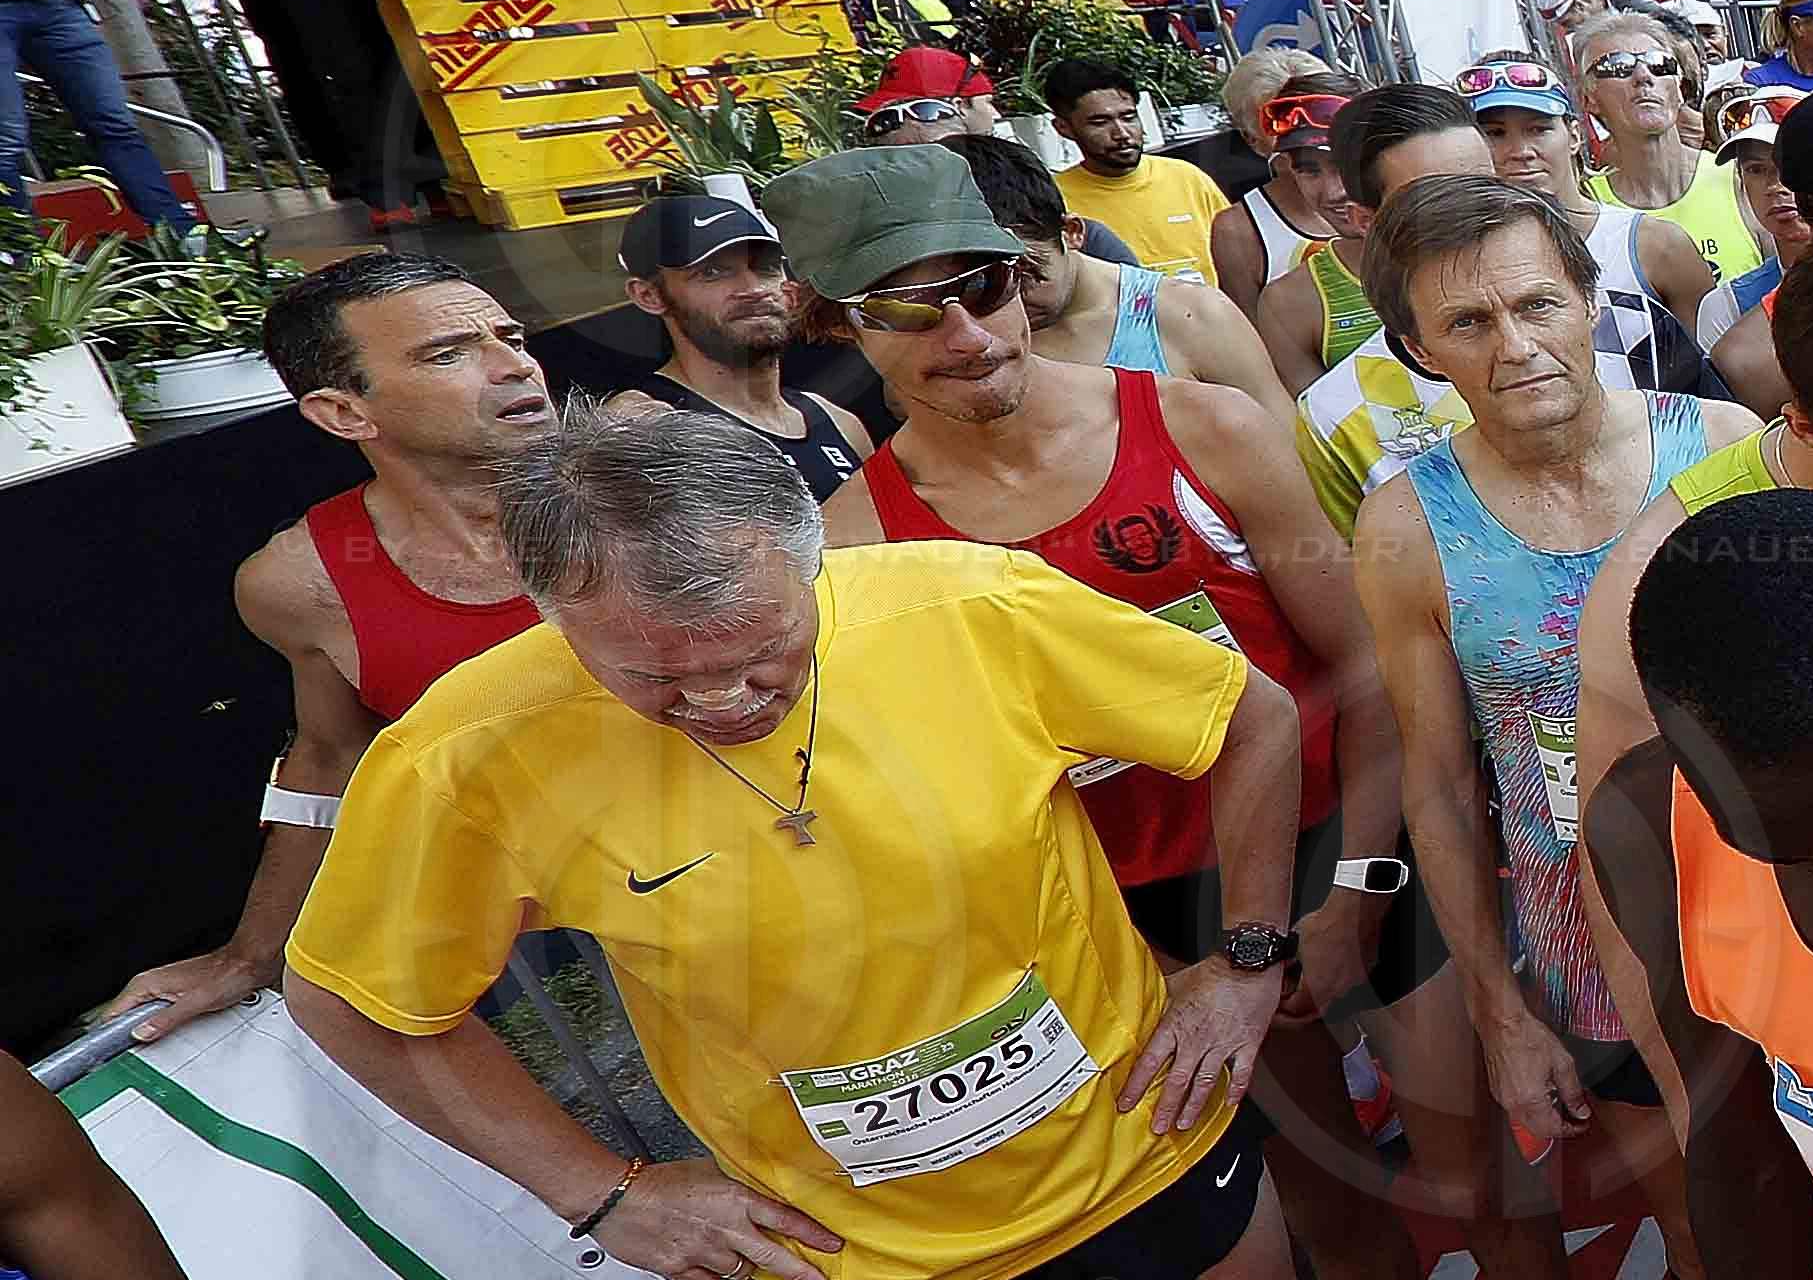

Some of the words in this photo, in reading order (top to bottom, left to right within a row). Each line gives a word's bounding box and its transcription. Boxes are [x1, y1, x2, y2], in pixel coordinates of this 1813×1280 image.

[841, 1071, 905, 1094] MARATHON
[850, 1051, 920, 1082] GRAZ
[854, 1034, 1035, 1133] 27025
[852, 1121, 928, 1147] Österreichische
[928, 1086, 1002, 1125] Meisterschaften
